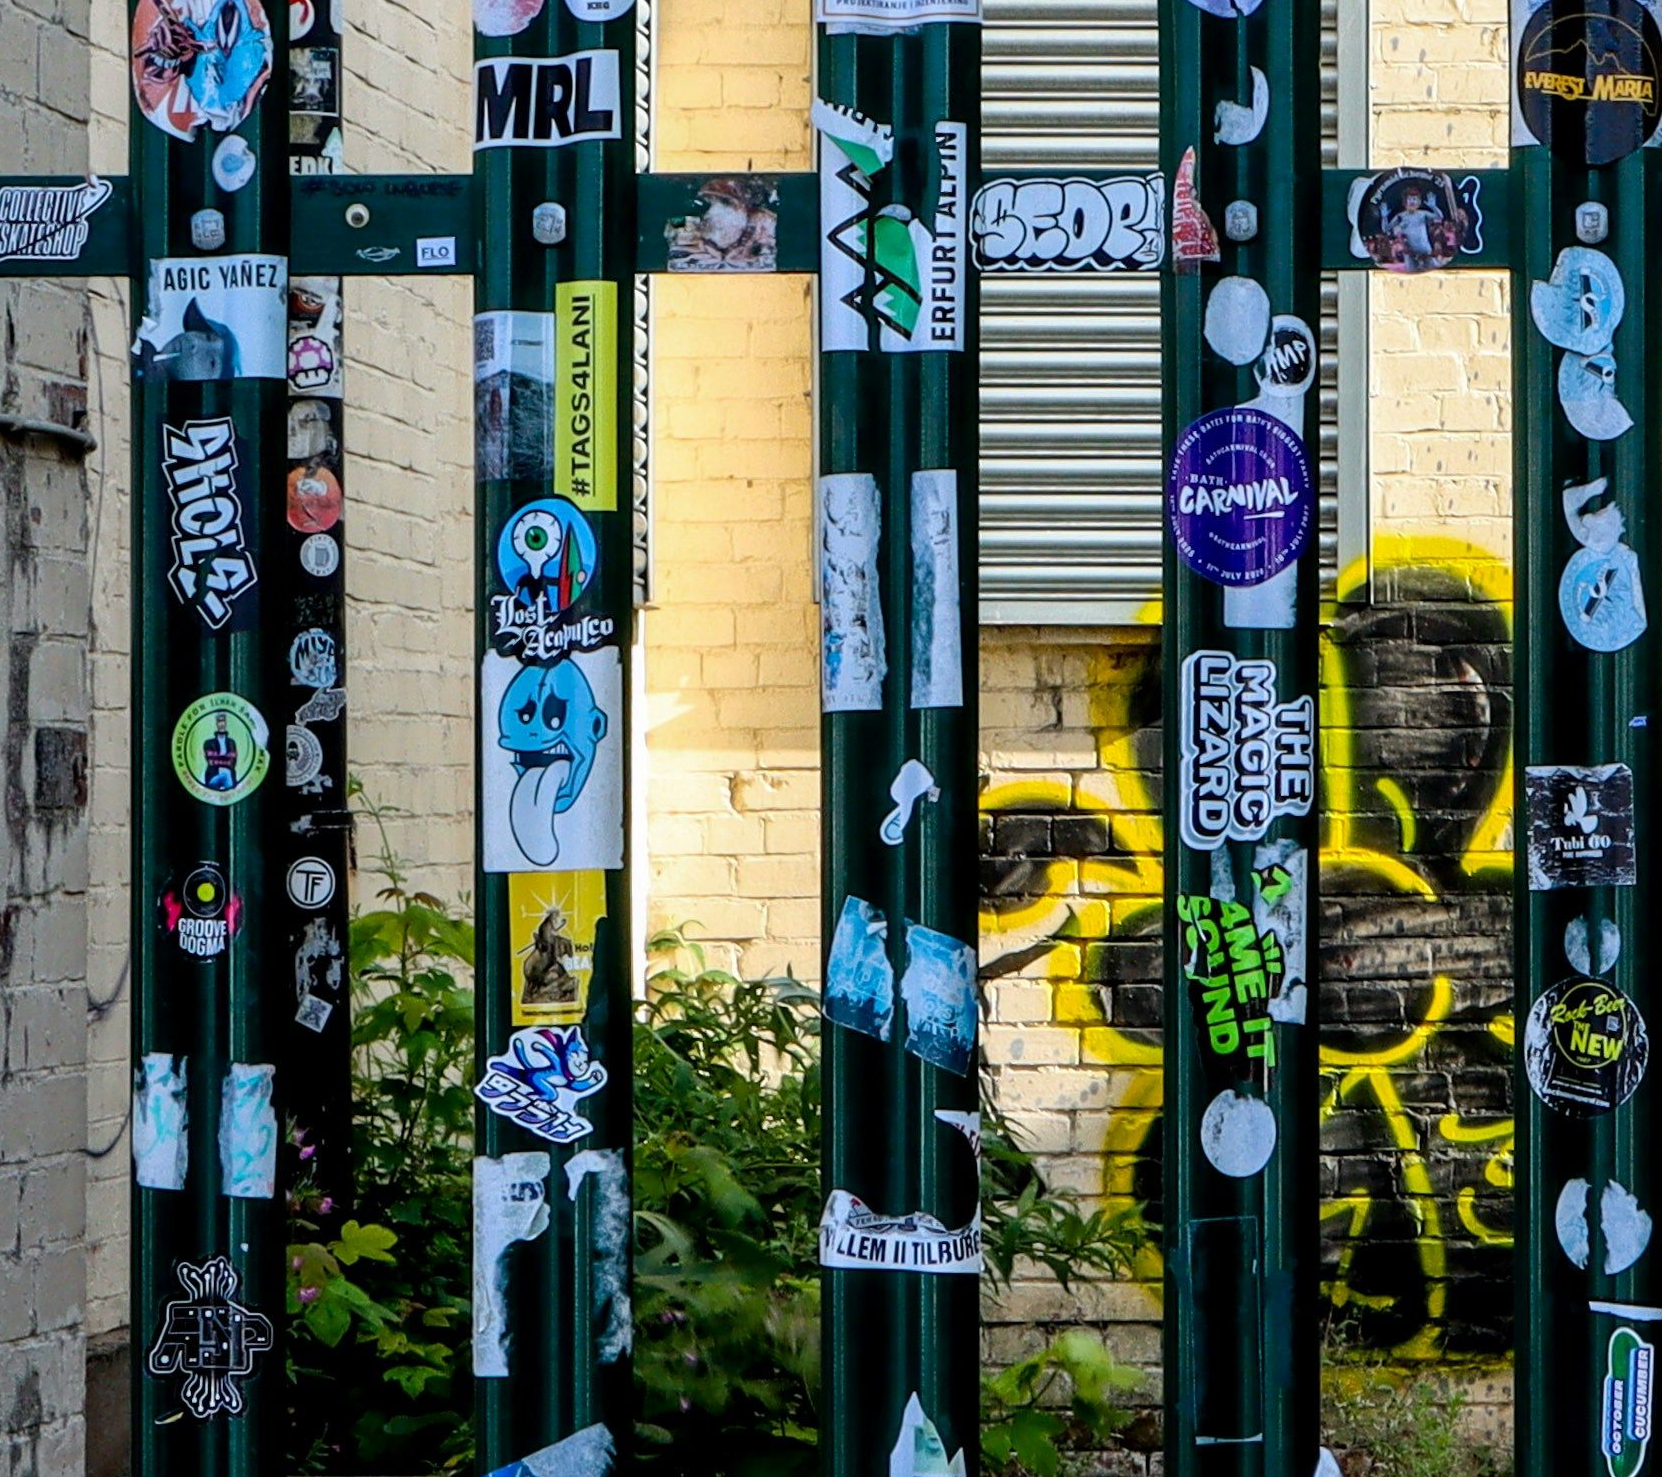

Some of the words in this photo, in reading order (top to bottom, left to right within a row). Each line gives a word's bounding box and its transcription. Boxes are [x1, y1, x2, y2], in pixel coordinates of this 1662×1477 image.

[474, 57, 614, 141] MRL
[1594, 67, 1653, 102] MARIA
[421, 245, 450, 260] FLO
[218, 261, 279, 290] YAÑEZ
[931, 230, 958, 343] ERFURT
[569, 291, 596, 497] #TAGS4LANI
[1179, 477, 1299, 516] CARNIVAL
[1190, 473, 1224, 485] BATH
[1197, 656, 1233, 836] LIZARD
[1235, 665, 1271, 827] MAGIC
[1275, 698, 1313, 809] THE
[1551, 834, 1584, 850] Tubi
[295, 870, 327, 902] TF
[178, 917, 227, 936] GROOVE
[1570, 1028, 1623, 1062] NEW
[1633, 1348, 1651, 1442] CUCUMBER
[1610, 1379, 1625, 1453] OCTOBER
